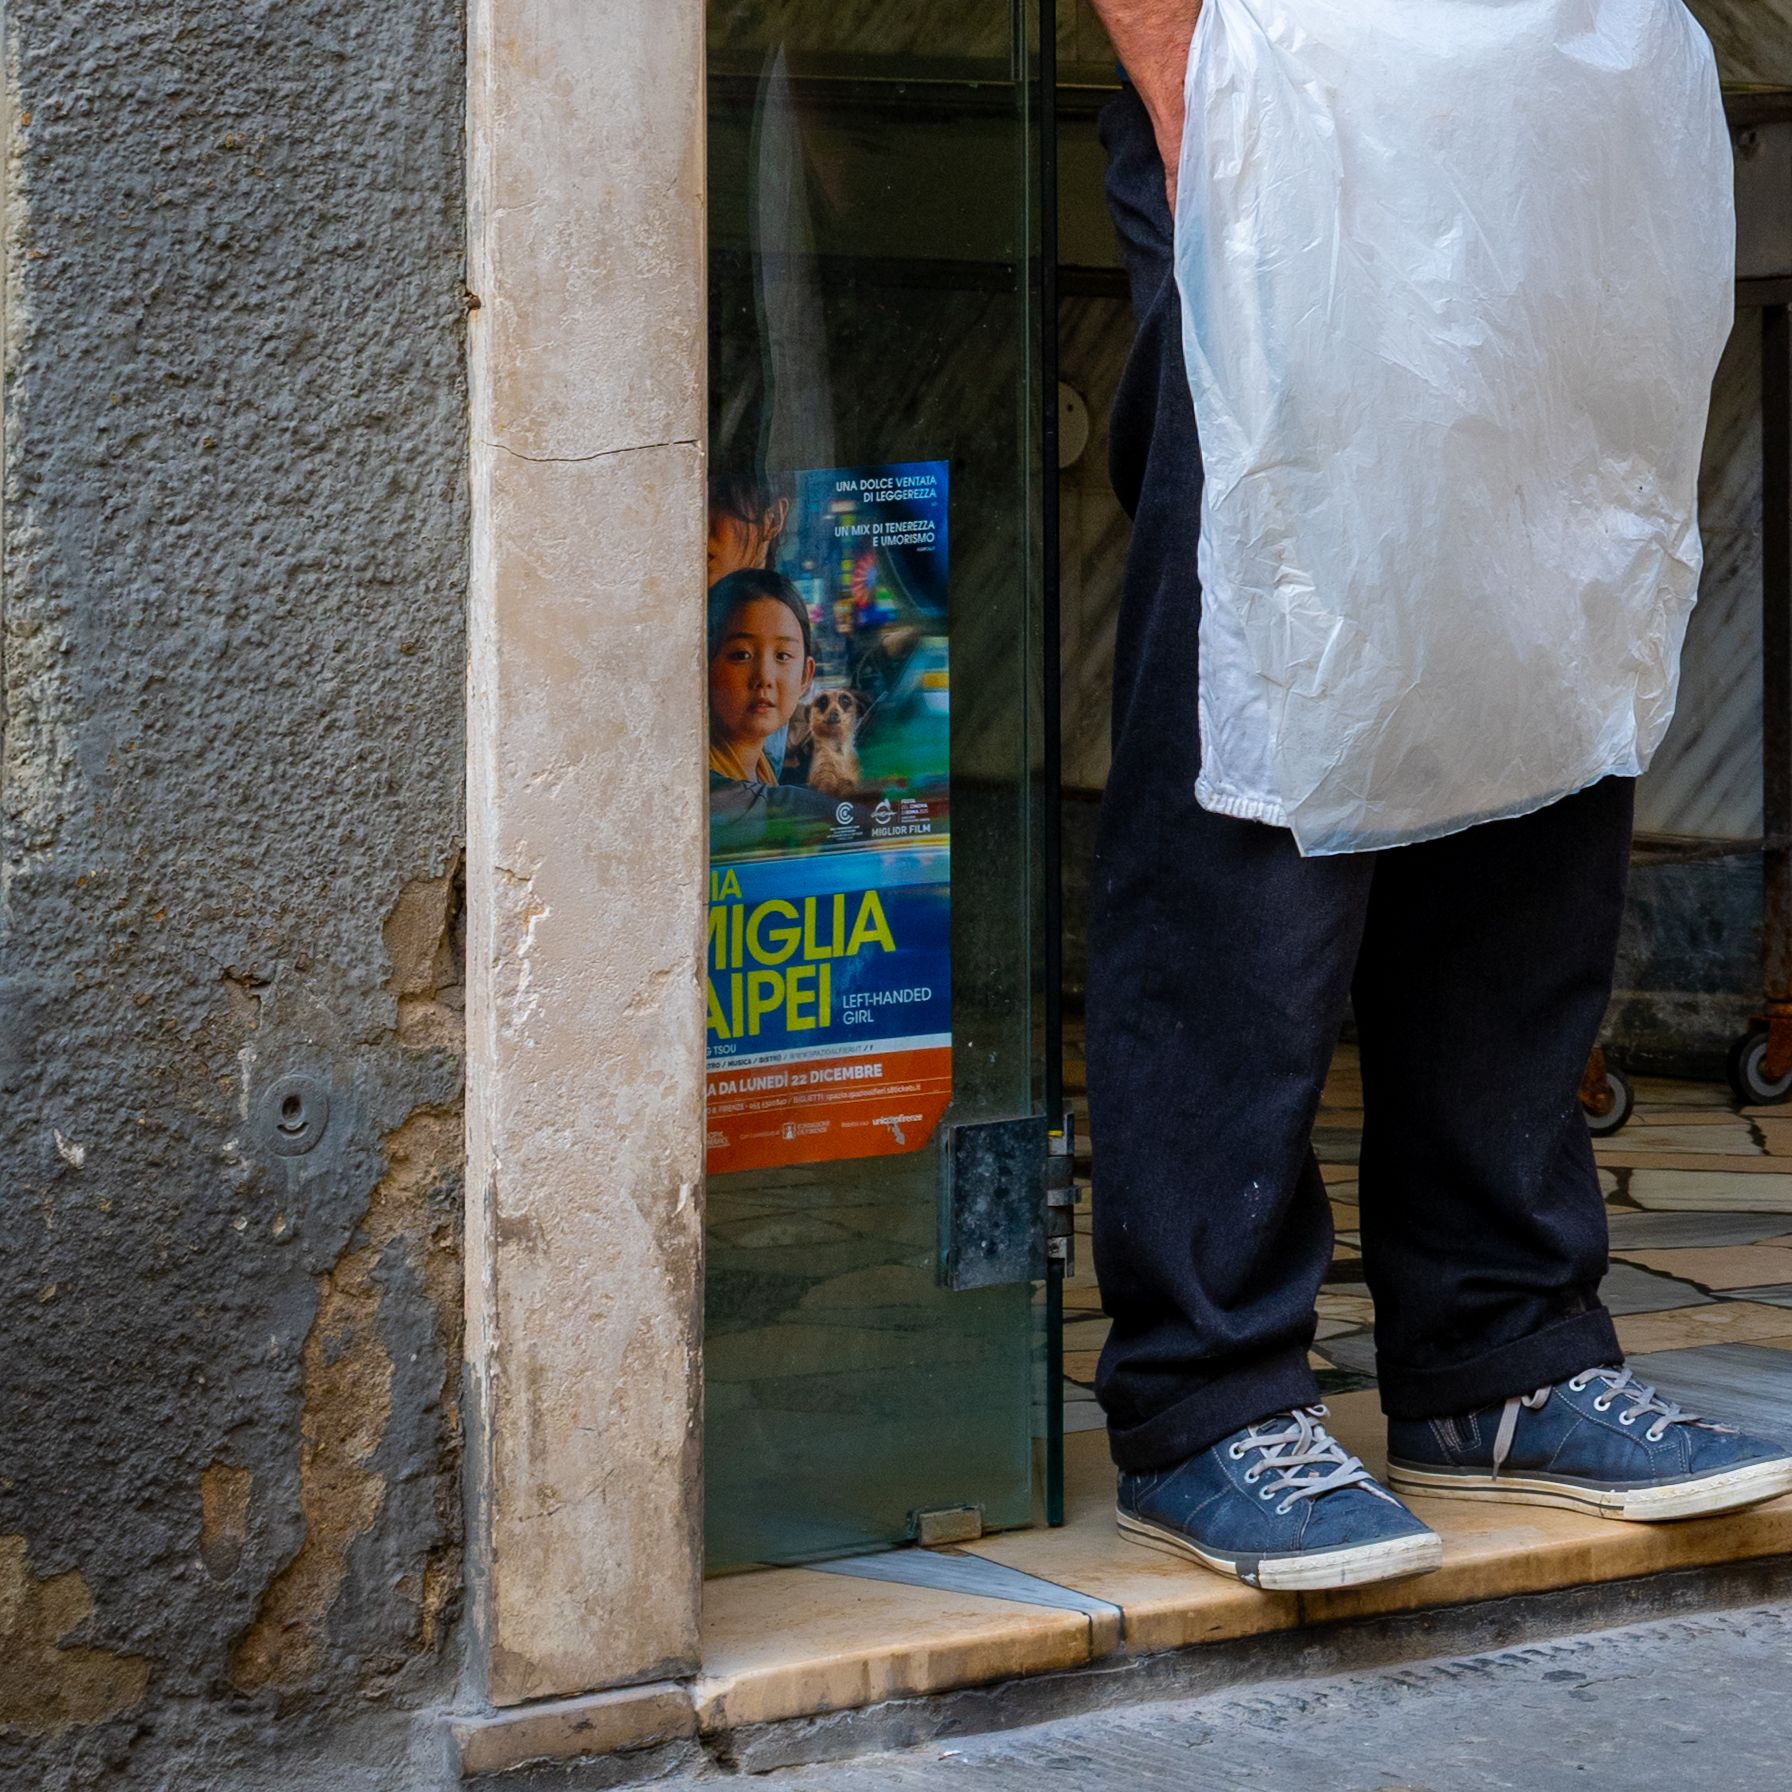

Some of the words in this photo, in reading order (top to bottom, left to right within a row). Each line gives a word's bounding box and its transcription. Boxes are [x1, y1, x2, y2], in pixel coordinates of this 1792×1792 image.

[836, 481, 858, 492] UNA
[860, 478, 893, 490] DOLCE
[895, 475, 937, 487] VENTATA
[864, 492, 874, 502] DI
[876, 489, 936, 501] LEGGEREZZA
[835, 527, 848, 537] UN
[852, 524, 870, 536] MIX
[873, 524, 883, 534] DI
[885, 520, 935, 533] TENEREZZA
[873, 537, 878, 547] E
[881, 533, 935, 545] UMORISMO
[871, 826, 907, 836] MIGLIOR
[909, 824, 931, 833] FILM
[842, 987, 932, 1009] LEFT-HANDED
[842, 1009, 874, 1025] GIRL
[719, 1081, 738, 1095] DA
[739, 1072, 789, 1092] LUNEDÌ
[791, 1074, 807, 1086] 22
[810, 1063, 883, 1084] DICEMBRE
